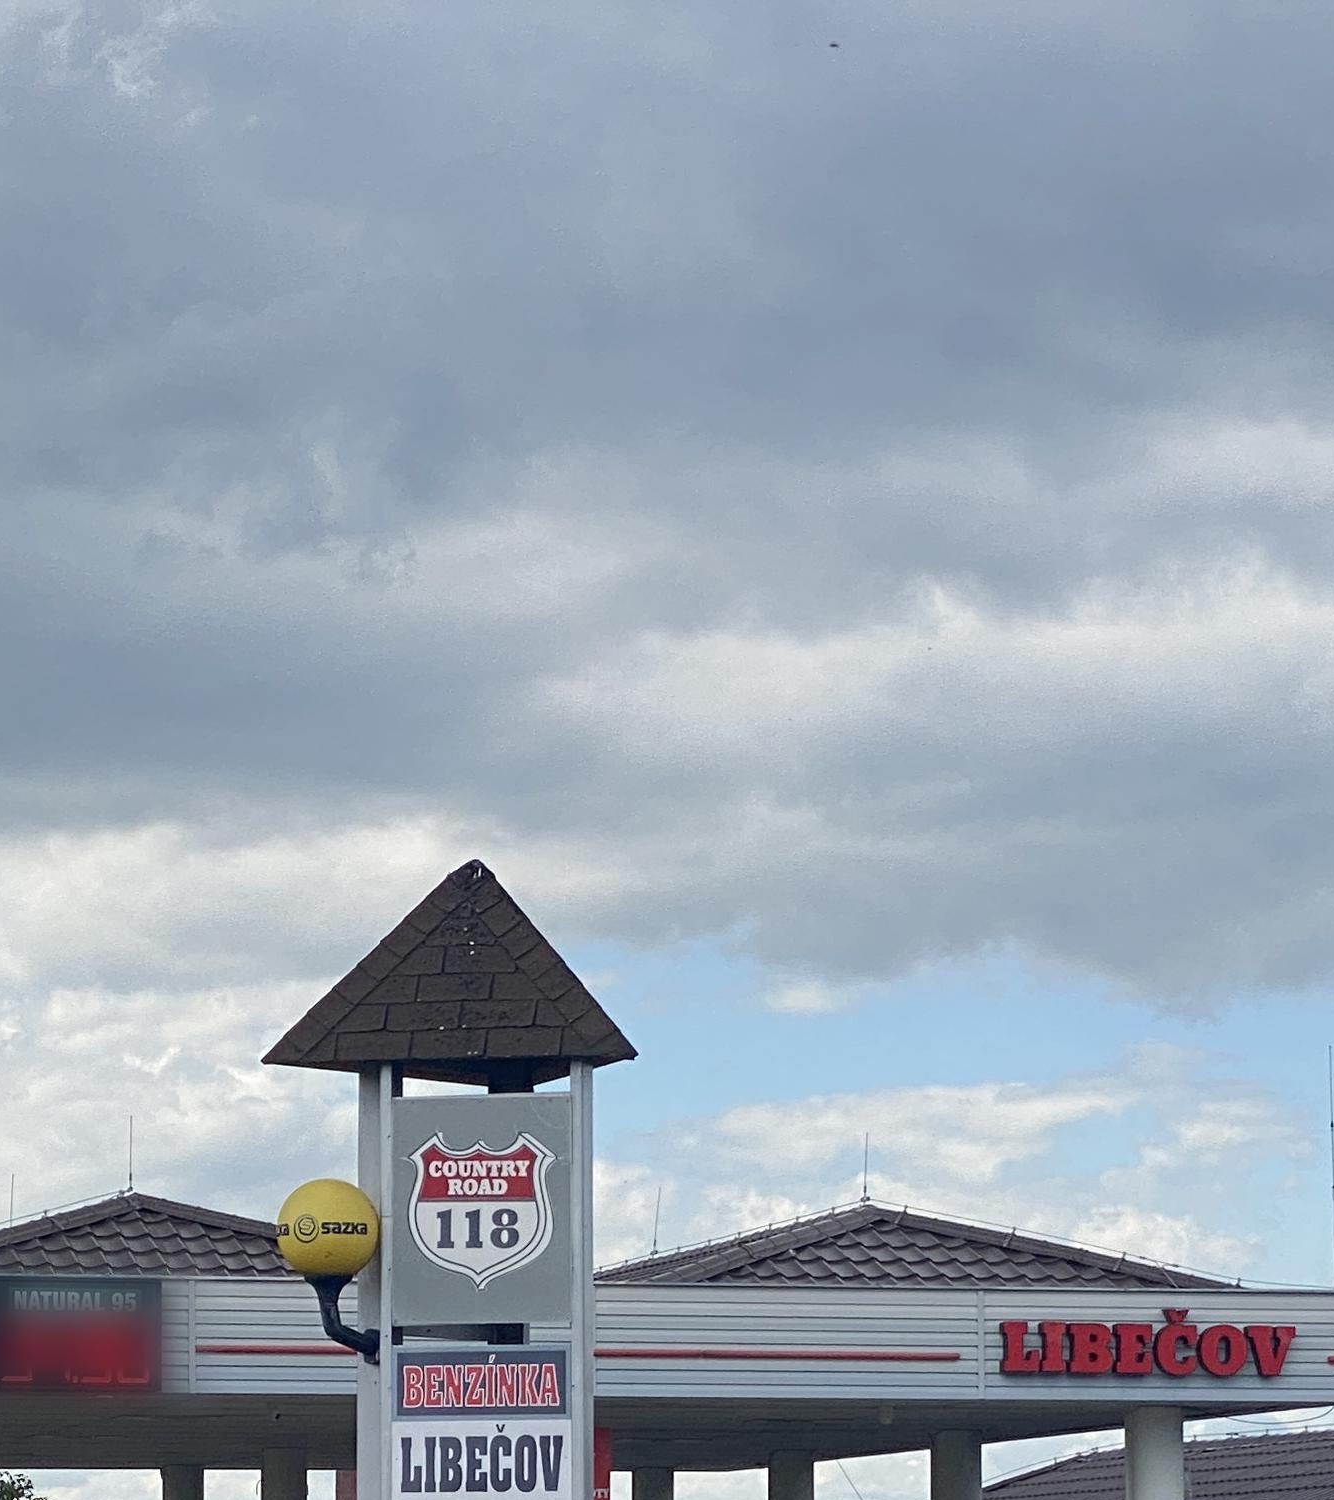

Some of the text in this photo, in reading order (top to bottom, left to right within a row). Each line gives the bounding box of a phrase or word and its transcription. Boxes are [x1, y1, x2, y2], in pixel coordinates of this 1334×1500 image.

[429, 1160, 530, 1177] COUNTRY
[447, 1179, 508, 1195] ROAD
[436, 1208, 520, 1249] 118
[14, 1290, 137, 1312] NATURAL 95
[1000, 1308, 1296, 1377] LIBEČOV
[403, 1354, 560, 1408] BENZÍNKA
[401, 1424, 563, 1493] LIBEČOV
